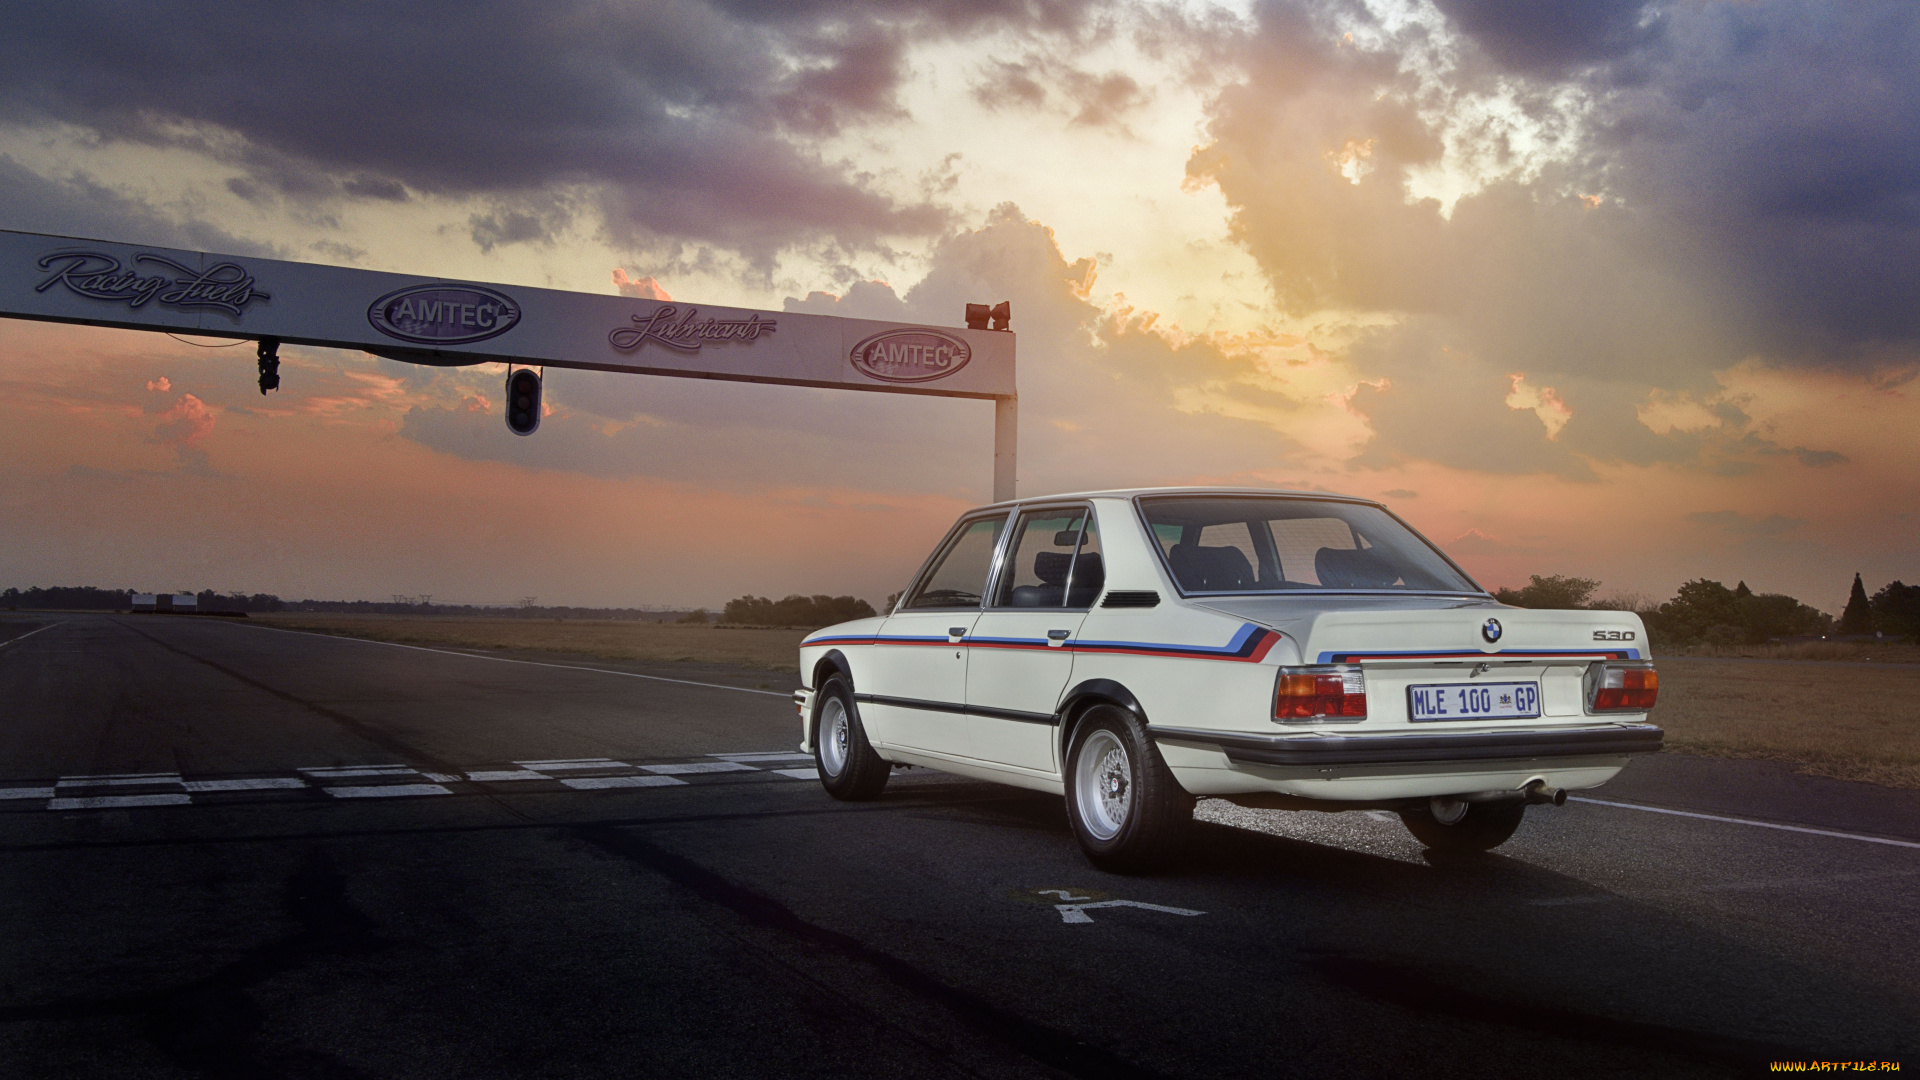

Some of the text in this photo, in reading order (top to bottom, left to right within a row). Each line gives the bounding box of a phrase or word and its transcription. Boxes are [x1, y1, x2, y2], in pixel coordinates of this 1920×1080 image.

[36, 253, 271, 316] Racing Fuels
[397, 298, 494, 328] AMTEC
[608, 305, 777, 350] Lubricants
[872, 342, 949, 367] AMTEC
[1592, 630, 1636, 641] 530
[1414, 686, 1536, 715] MLE 100 GP
